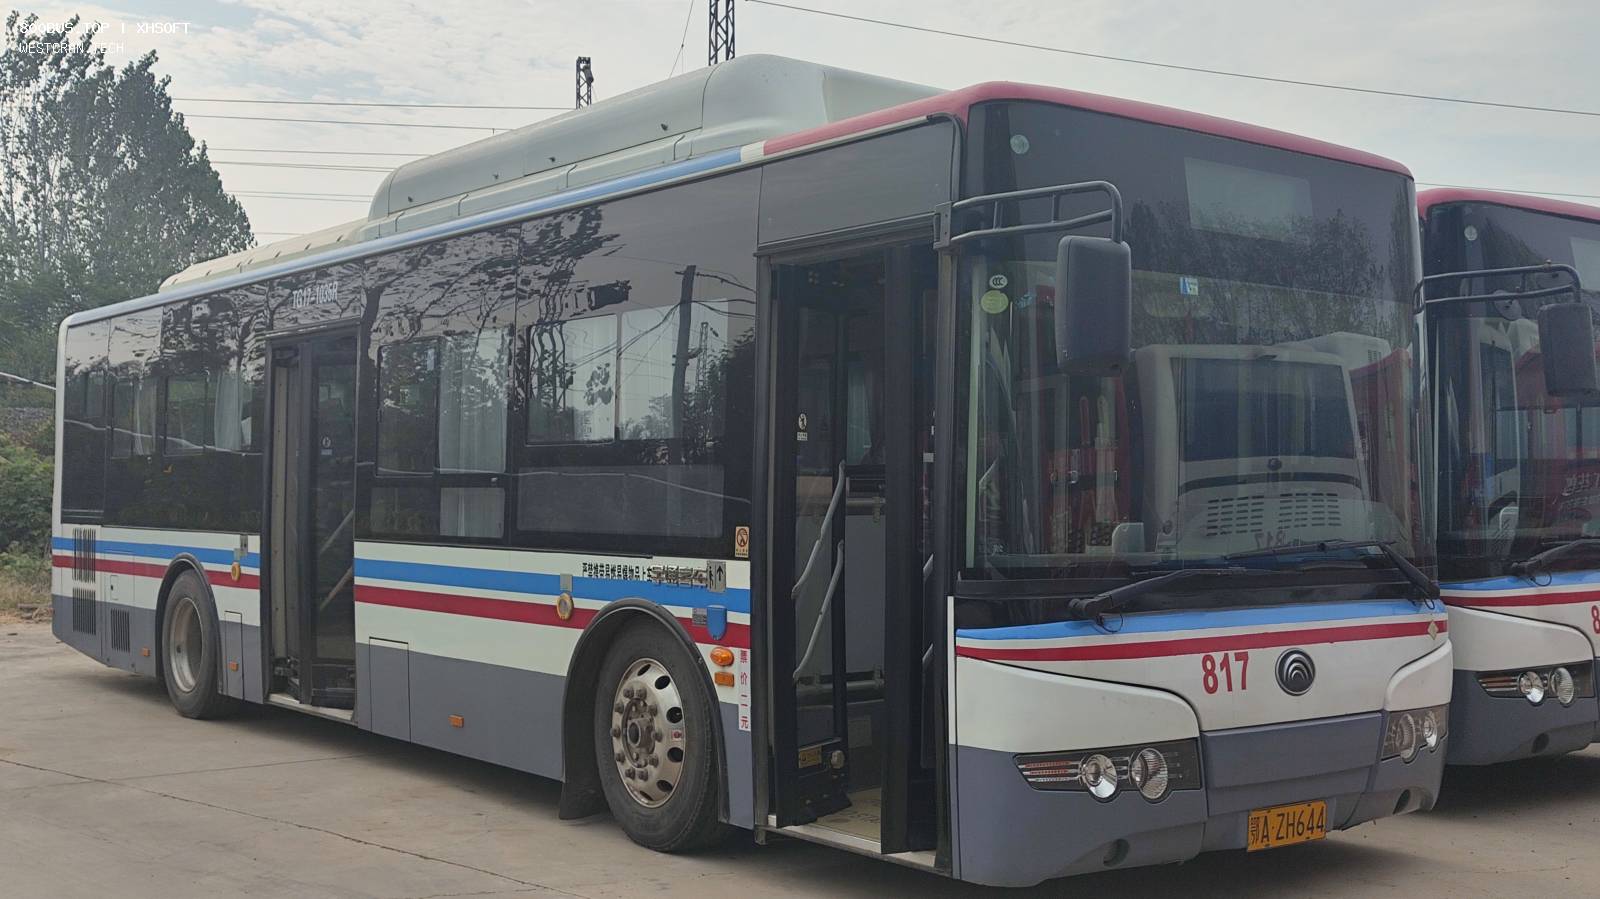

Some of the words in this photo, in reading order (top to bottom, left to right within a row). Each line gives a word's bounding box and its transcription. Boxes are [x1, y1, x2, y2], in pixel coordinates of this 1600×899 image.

[740, 650, 749, 729] 票价二元
[1202, 651, 1249, 694] 817
